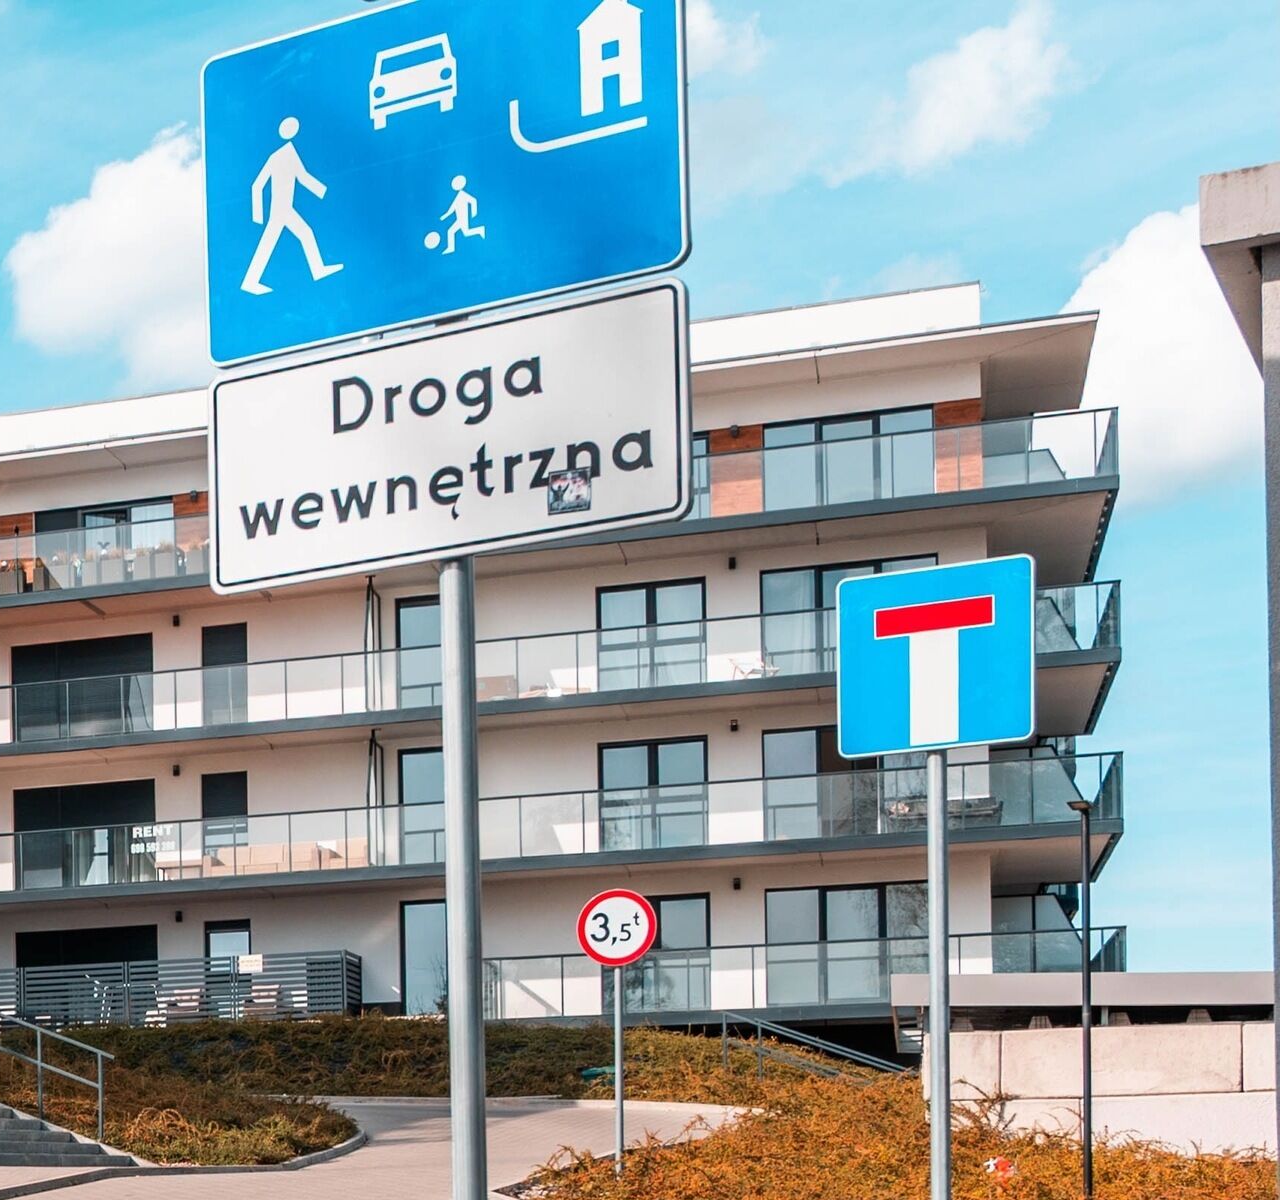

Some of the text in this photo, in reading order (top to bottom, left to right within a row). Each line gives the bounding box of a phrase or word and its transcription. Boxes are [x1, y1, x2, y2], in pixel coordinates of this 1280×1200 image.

[332, 355, 544, 434] Droga
[240, 427, 654, 540] wewnętrzna
[132, 824, 173, 838] RENT
